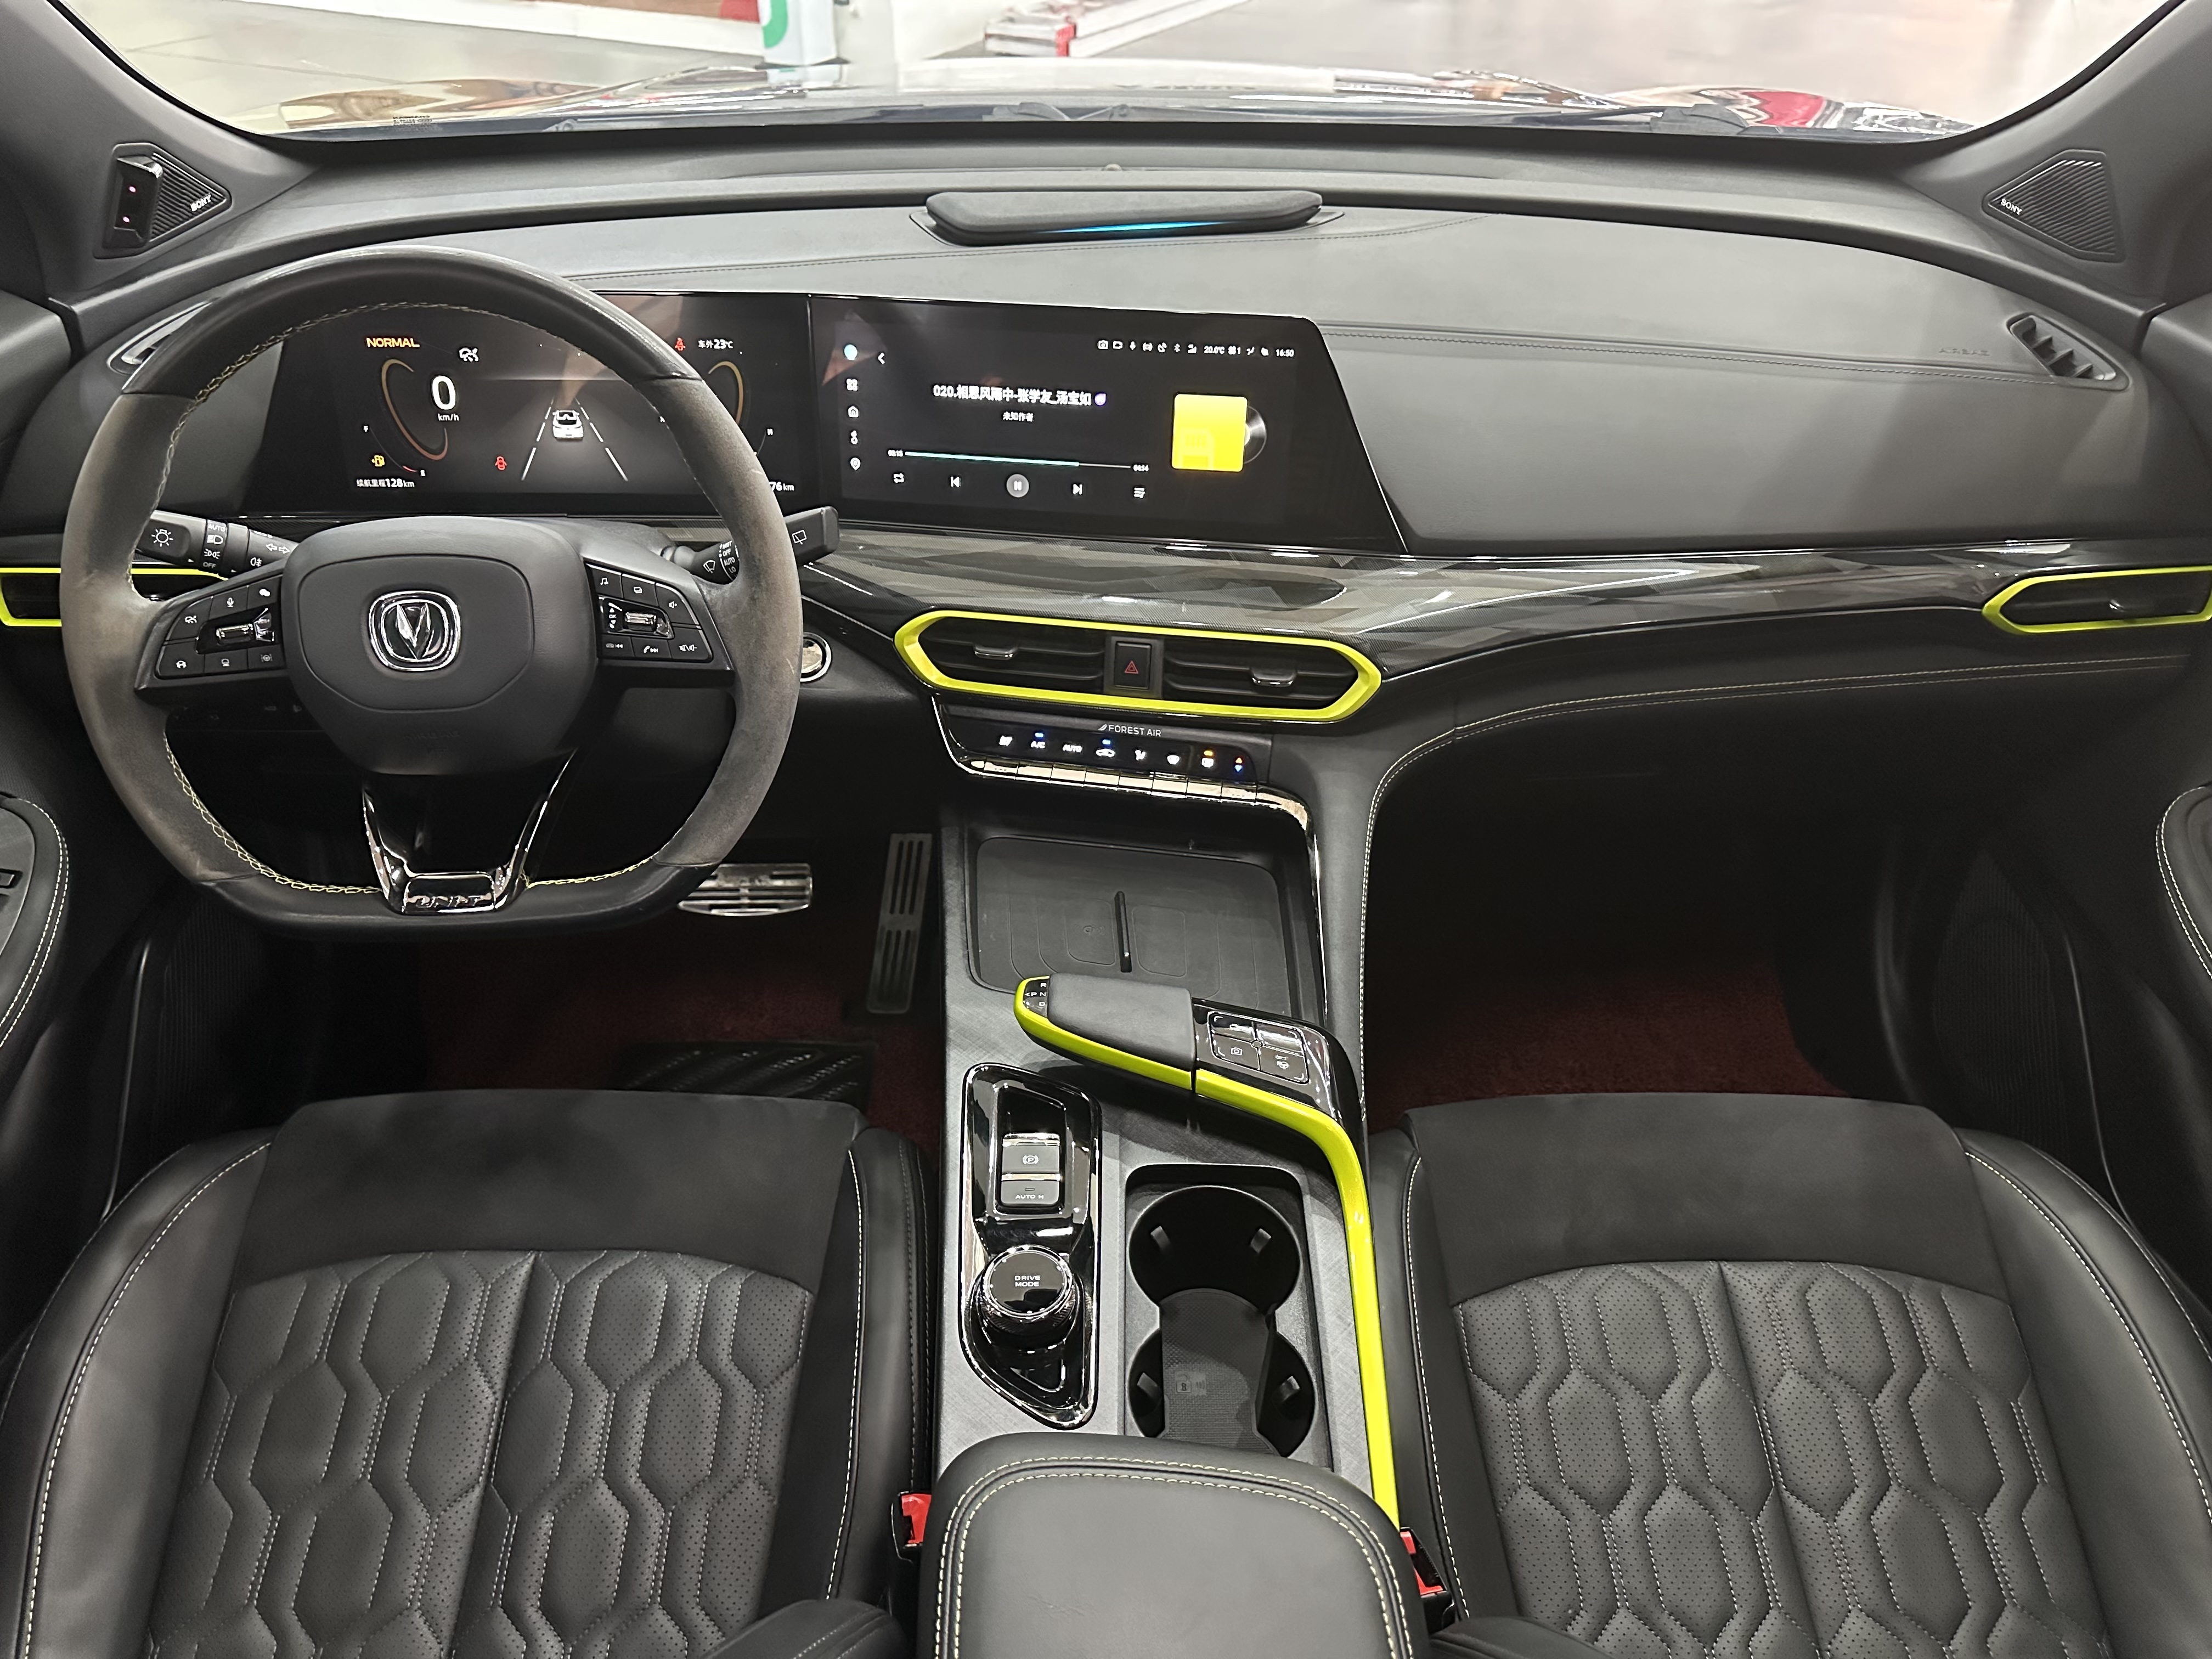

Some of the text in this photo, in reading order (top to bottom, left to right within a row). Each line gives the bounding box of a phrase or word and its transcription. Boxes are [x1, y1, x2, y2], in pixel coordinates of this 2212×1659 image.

[190, 194, 211, 212] SONY
[2000, 198, 2023, 215] SONY
[366, 337, 420, 348] NORMAL
[431, 375, 456, 410] 0
[438, 413, 460, 422] km/h
[1002, 411, 1034, 422] 未知作者
[207, 523, 227, 533] AUTO
[723, 548, 732, 557] OFF
[724, 556, 736, 567] AUTO
[1108, 724, 1162, 737] FOREST AIR
[1030, 741, 1046, 749] A/C
[1062, 744, 1083, 753] AUTO
